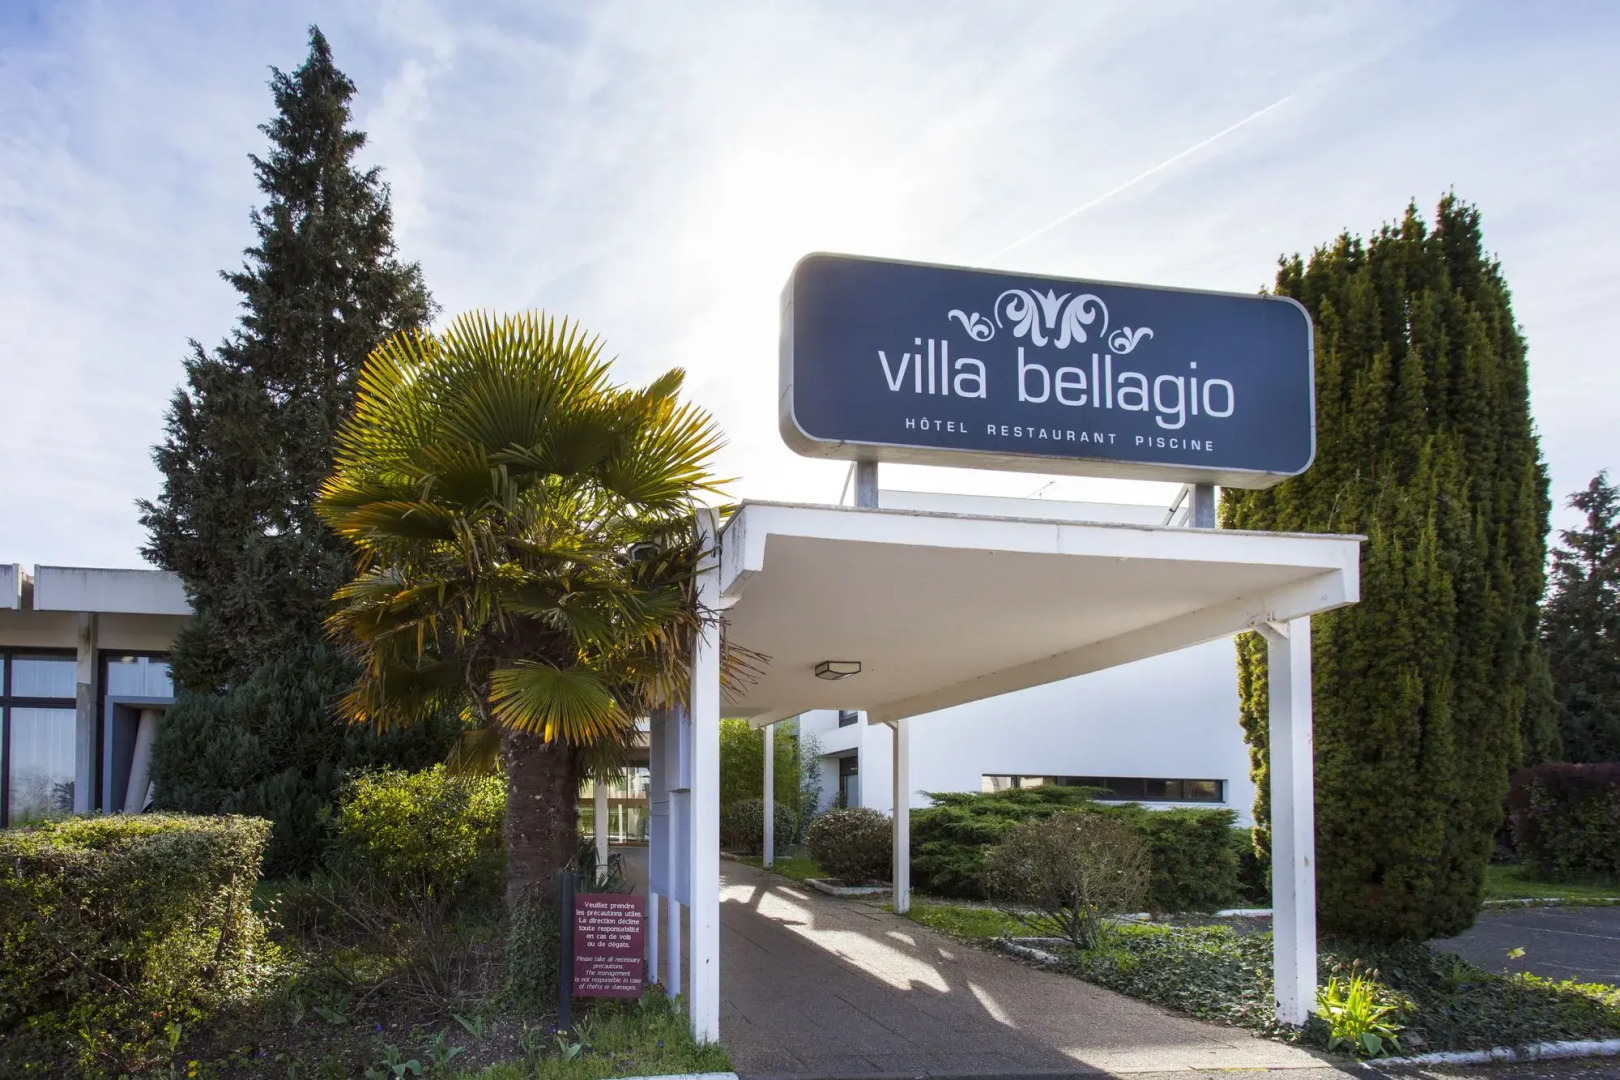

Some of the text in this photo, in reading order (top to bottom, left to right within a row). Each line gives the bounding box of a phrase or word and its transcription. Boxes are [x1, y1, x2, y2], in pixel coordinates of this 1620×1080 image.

[878, 337, 1235, 429] villa bellagio
[906, 416, 1214, 451] HÔTEL RESTAURANT PISCINE
